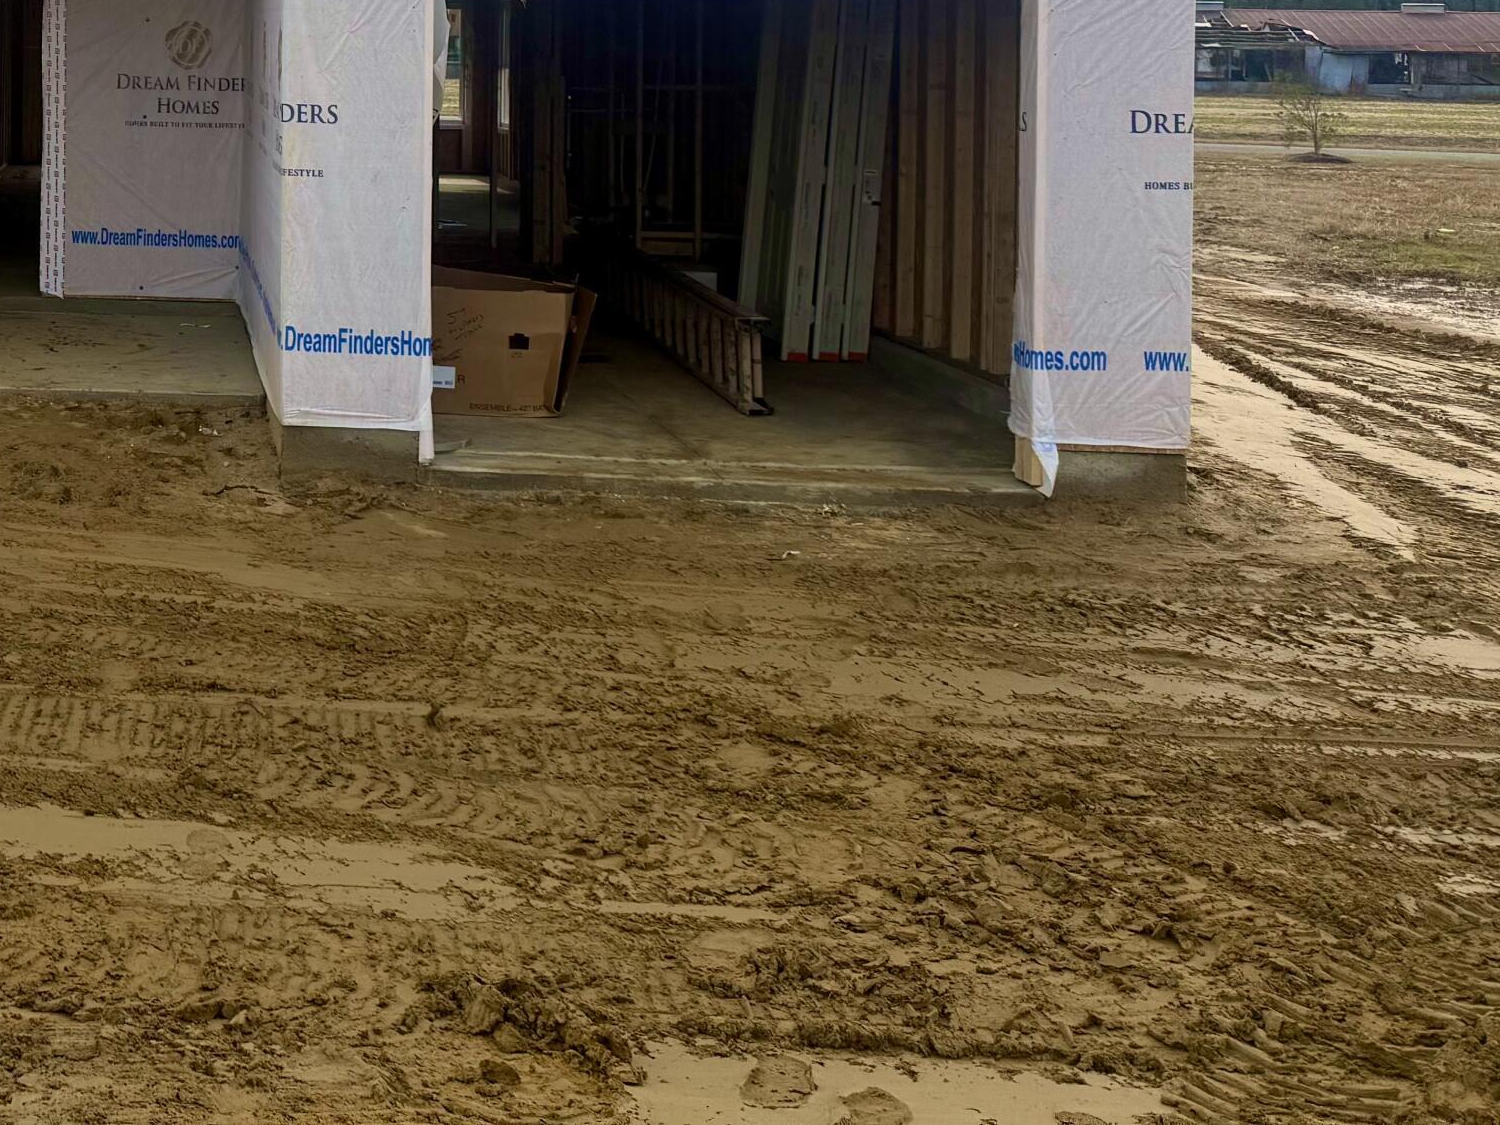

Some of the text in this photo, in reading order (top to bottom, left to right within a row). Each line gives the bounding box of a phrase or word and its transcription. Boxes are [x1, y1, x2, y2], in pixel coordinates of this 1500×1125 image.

[116, 73, 181, 91] DREAM
[157, 97, 220, 115] HOMES
[1144, 181, 1180, 190] HOMES
